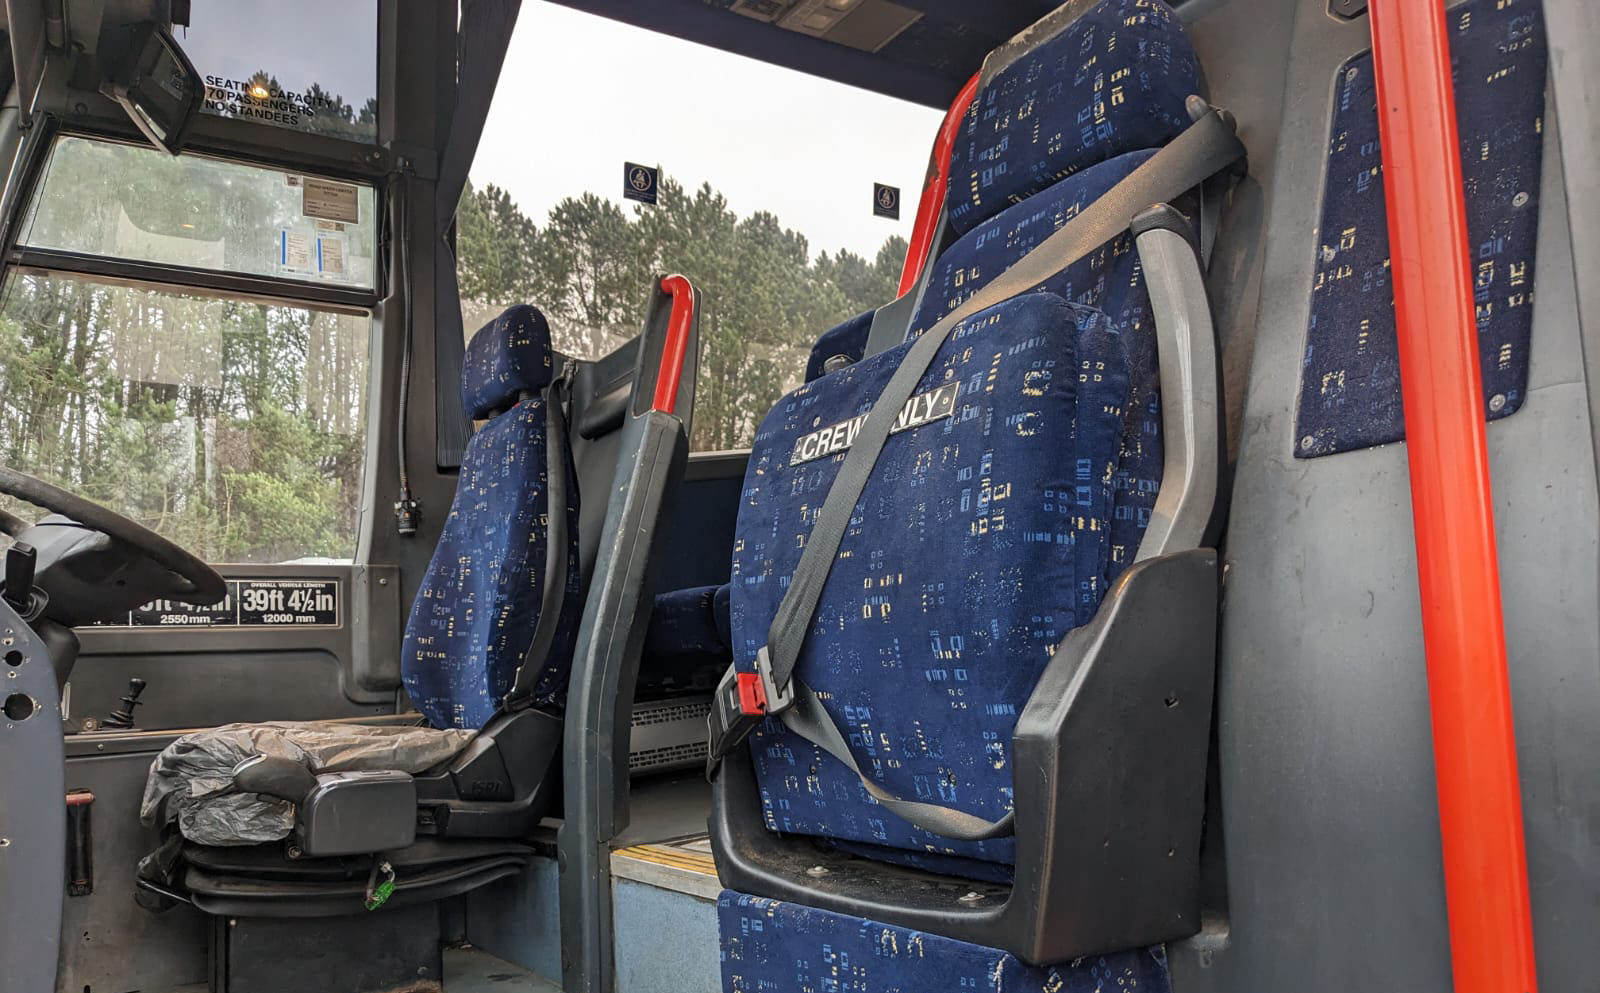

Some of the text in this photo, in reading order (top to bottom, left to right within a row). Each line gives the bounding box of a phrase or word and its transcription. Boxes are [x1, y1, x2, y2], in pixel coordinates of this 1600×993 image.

[206, 75, 333, 109] SEATIN CAPACITY
[208, 87, 315, 117] 70 PASSENGERS
[205, 99, 299, 125] NO STANDEES
[891, 388, 944, 429] NLY
[243, 589, 285, 612] 39ft
[160, 614, 211, 624] 2550 mm
[262, 613, 316, 623] 12000 mm
